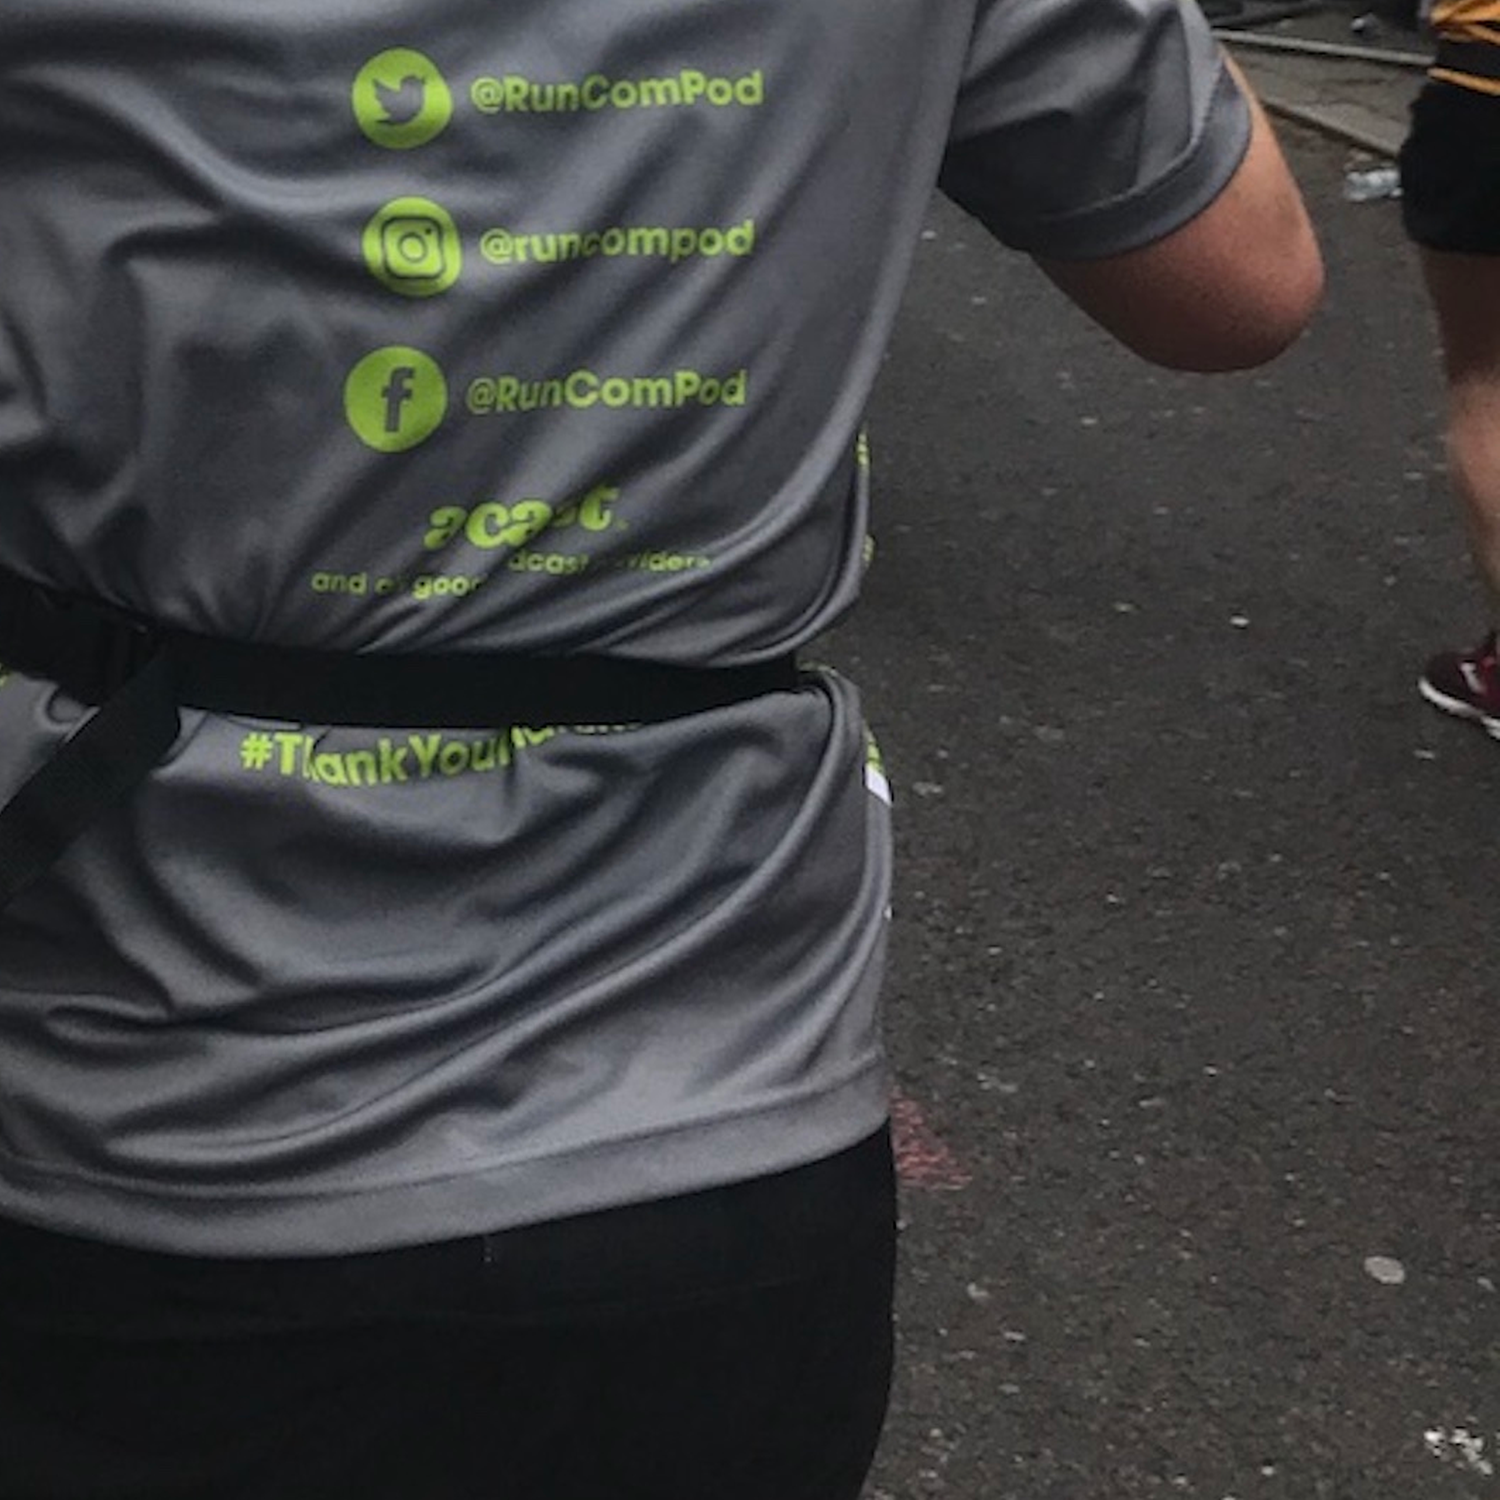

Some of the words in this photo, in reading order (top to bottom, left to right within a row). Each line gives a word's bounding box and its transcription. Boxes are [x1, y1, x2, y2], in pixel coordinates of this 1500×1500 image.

[470, 70, 764, 115] @RunComPod
[480, 220, 755, 265] @runcompod
[467, 369, 747, 415] @RunComPod
[311, 571, 367, 595] and
